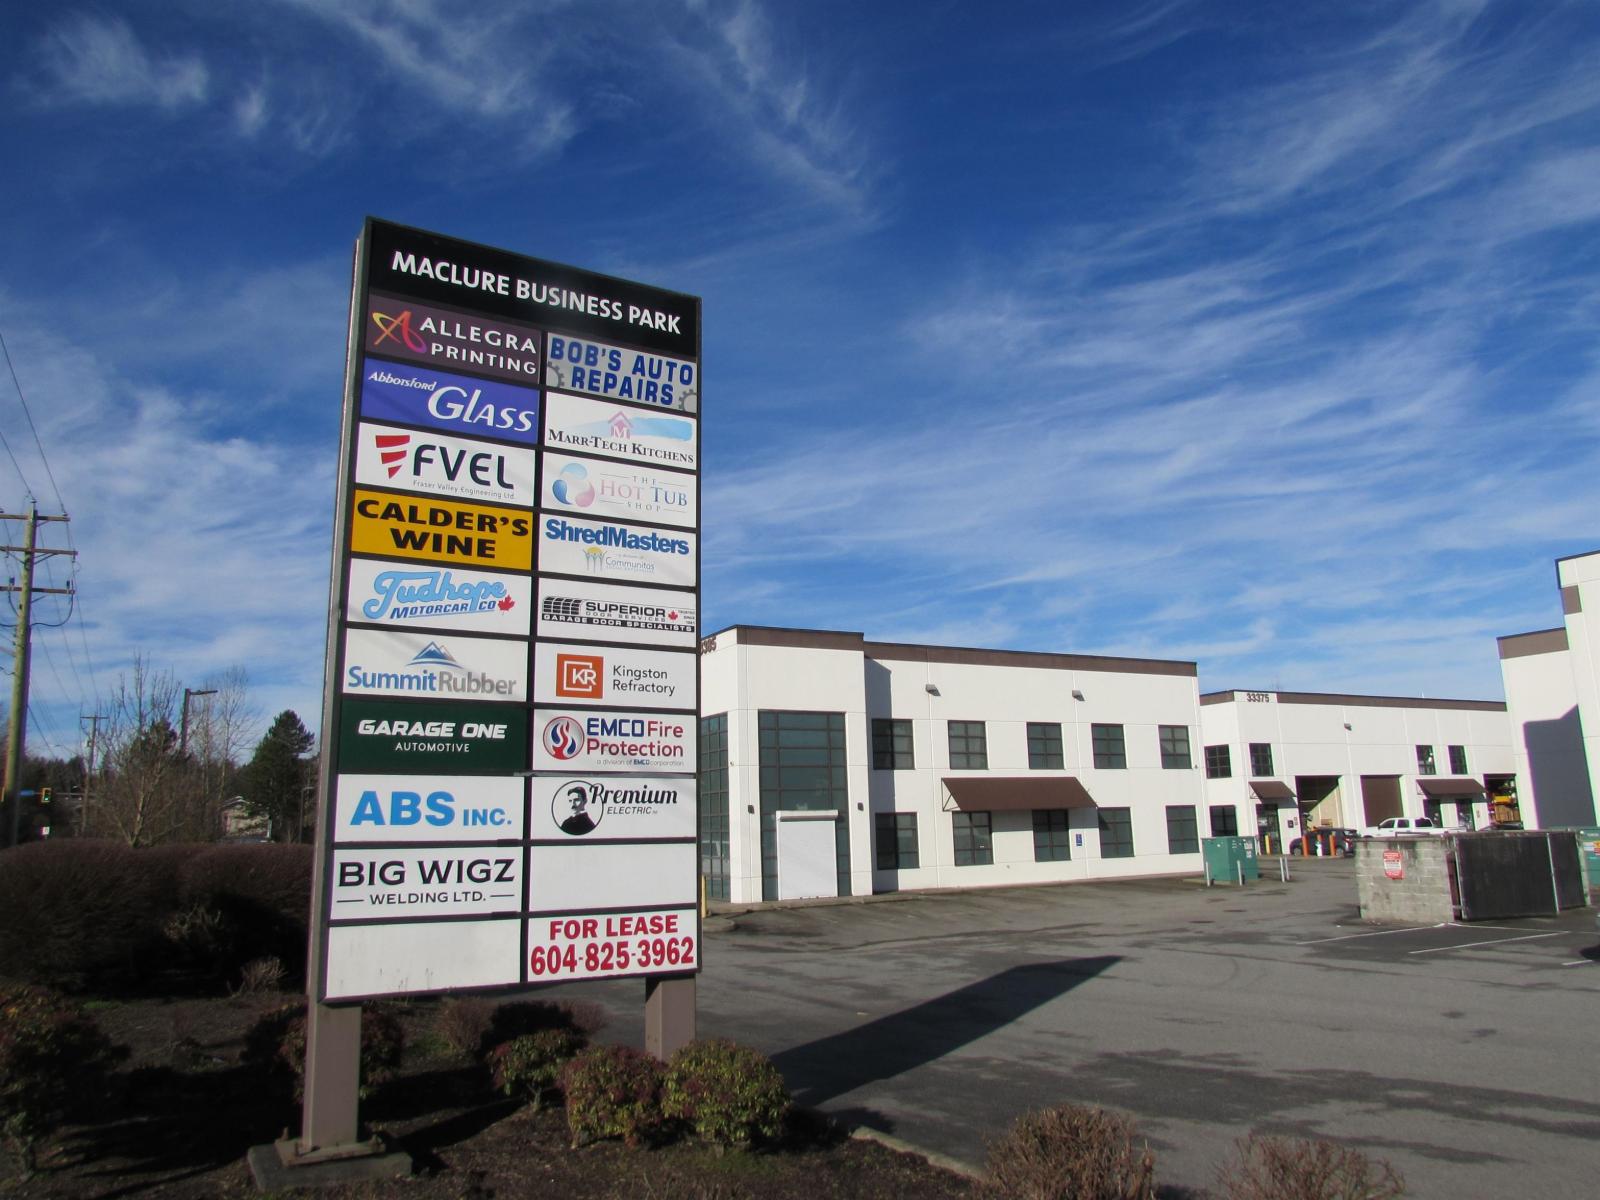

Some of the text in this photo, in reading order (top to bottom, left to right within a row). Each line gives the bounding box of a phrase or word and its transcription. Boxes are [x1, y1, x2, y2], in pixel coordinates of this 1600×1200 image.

[392, 251, 681, 335] MACLURE BUSINESS PARK
[419, 317, 537, 353] ALLEGRA
[431, 343, 537, 374] PRINTING
[550, 337, 693, 386] BOB'S AUTO
[571, 366, 674, 406] REPAIRS
[632, 443, 694, 464] KITCHENS
[413, 444, 514, 490] FVEL
[413, 479, 435, 489] Fraser
[437, 482, 458, 493] Valley
[461, 486, 502, 499] Engineering
[633, 475, 656, 485] THE
[600, 480, 688, 507] HOT TUB
[627, 501, 662, 512] SHOP
[357, 499, 529, 537] CALDER'S
[390, 528, 496, 559] WINE
[545, 518, 690, 555] ShredMasters
[363, 570, 507, 619] Tudhope
[390, 603, 469, 619] MOTORCAR
[586, 601, 666, 617] SUPERIOR
[618, 613, 666, 622] SERVICES
[543, 614, 588, 624] GARAGE
[592, 618, 622, 627] DOOR
[626, 621, 692, 632] SPECIALISTS
[572, 668, 597, 686] KR
[613, 665, 668, 681] Kingston
[612, 679, 676, 696] Refractory
[1246, 692, 1270, 703] 33375
[358, 719, 508, 739] GARAGE ONE
[648, 720, 684, 738] Fire
[395, 742, 470, 753] AUTOMOTIVE
[587, 738, 684, 758] Protection
[589, 782, 678, 805] Premium
[350, 791, 512, 827] ABS INC.
[607, 806, 652, 815] ELECTRIC
[339, 859, 515, 887] BIG WIGZ
[370, 891, 486, 905] WELDING LTD.
[550, 914, 678, 941] FOR LEASE
[531, 936, 694, 976] 604-825-3962
